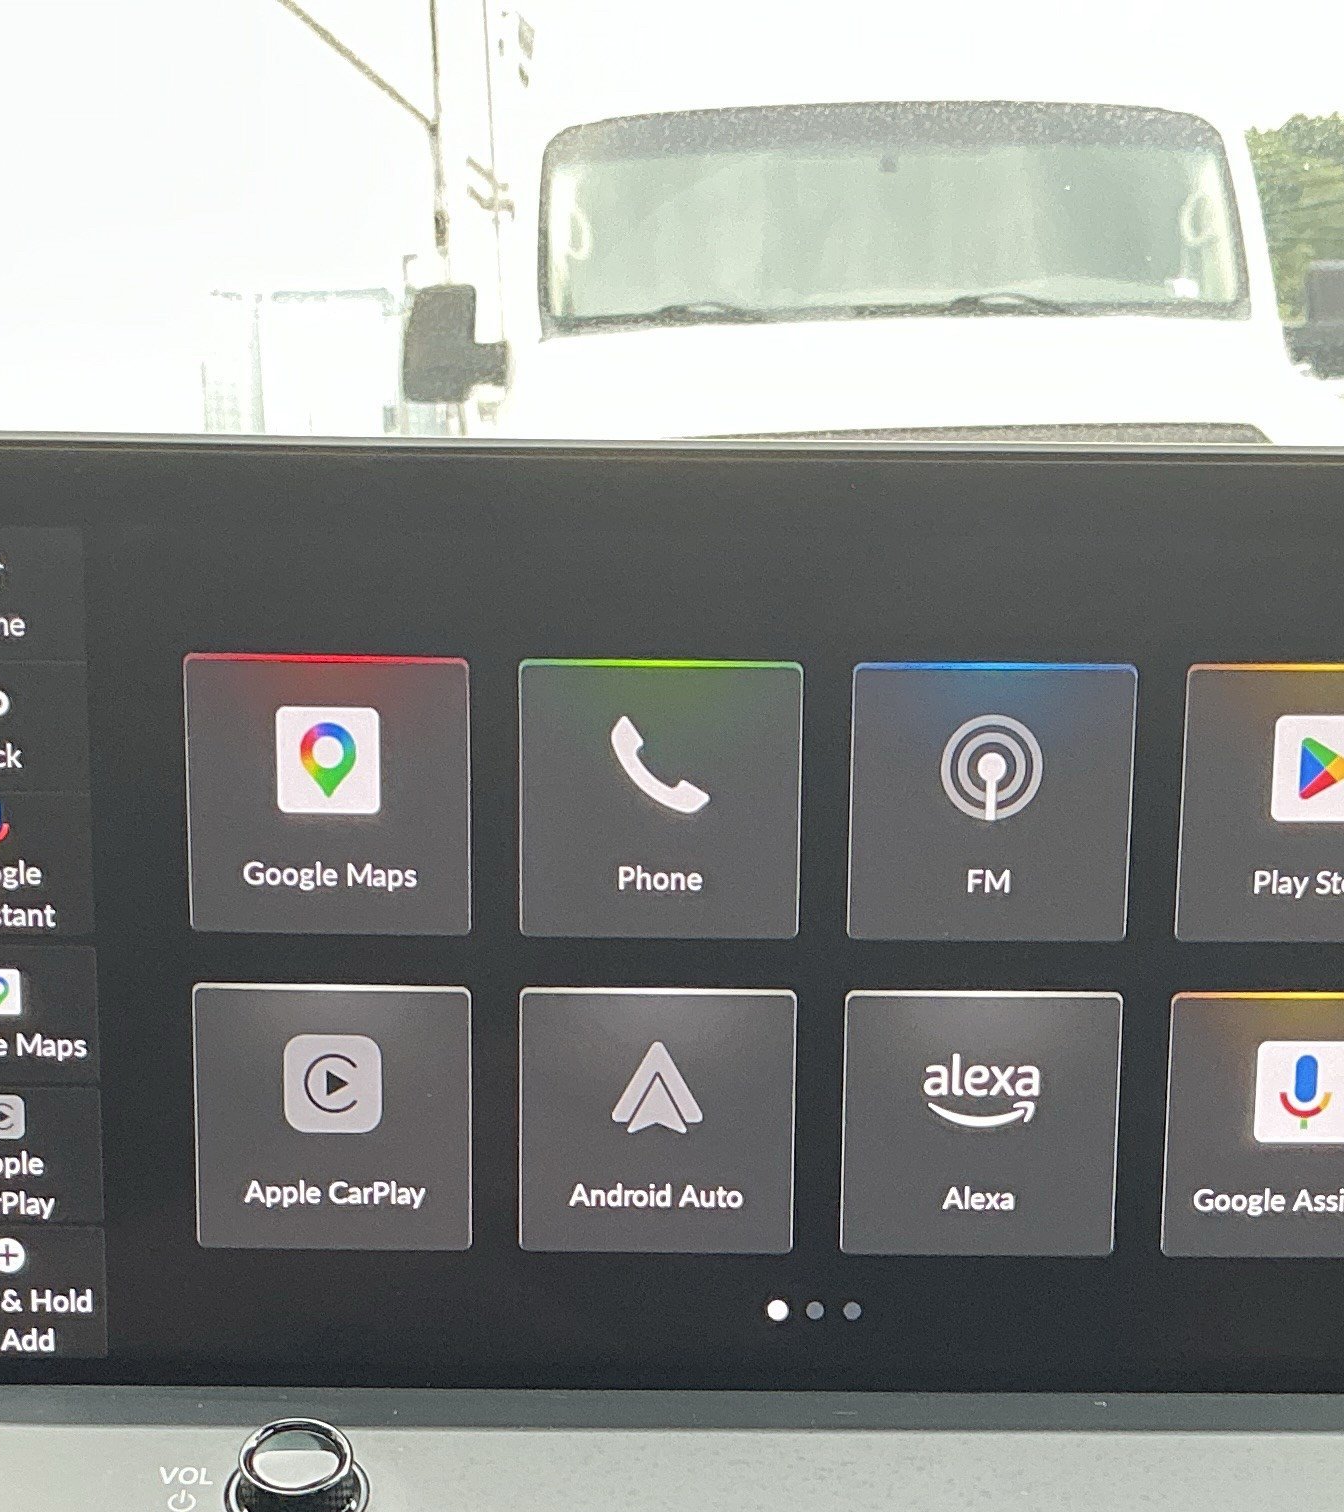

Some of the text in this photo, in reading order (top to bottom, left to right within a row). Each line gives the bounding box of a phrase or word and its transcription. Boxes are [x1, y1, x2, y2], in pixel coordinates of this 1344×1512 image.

[243, 860, 418, 892] Google Maps
[618, 864, 703, 892] Phone
[967, 868, 1011, 894] FM
[1253, 869, 1310, 899] Play
[16, 1032, 88, 1062] Maps
[923, 1052, 1041, 1098] alexa
[243, 1179, 426, 1210] Apple CarPlay
[568, 1182, 744, 1209] Android Auto
[941, 1185, 1015, 1211] Alexa
[1193, 1187, 1286, 1217] Google
[0, 1288, 23, 1313] &
[30, 1288, 93, 1313] Hold
[0, 1327, 55, 1353] Add
[159, 1466, 213, 1486] VOL
